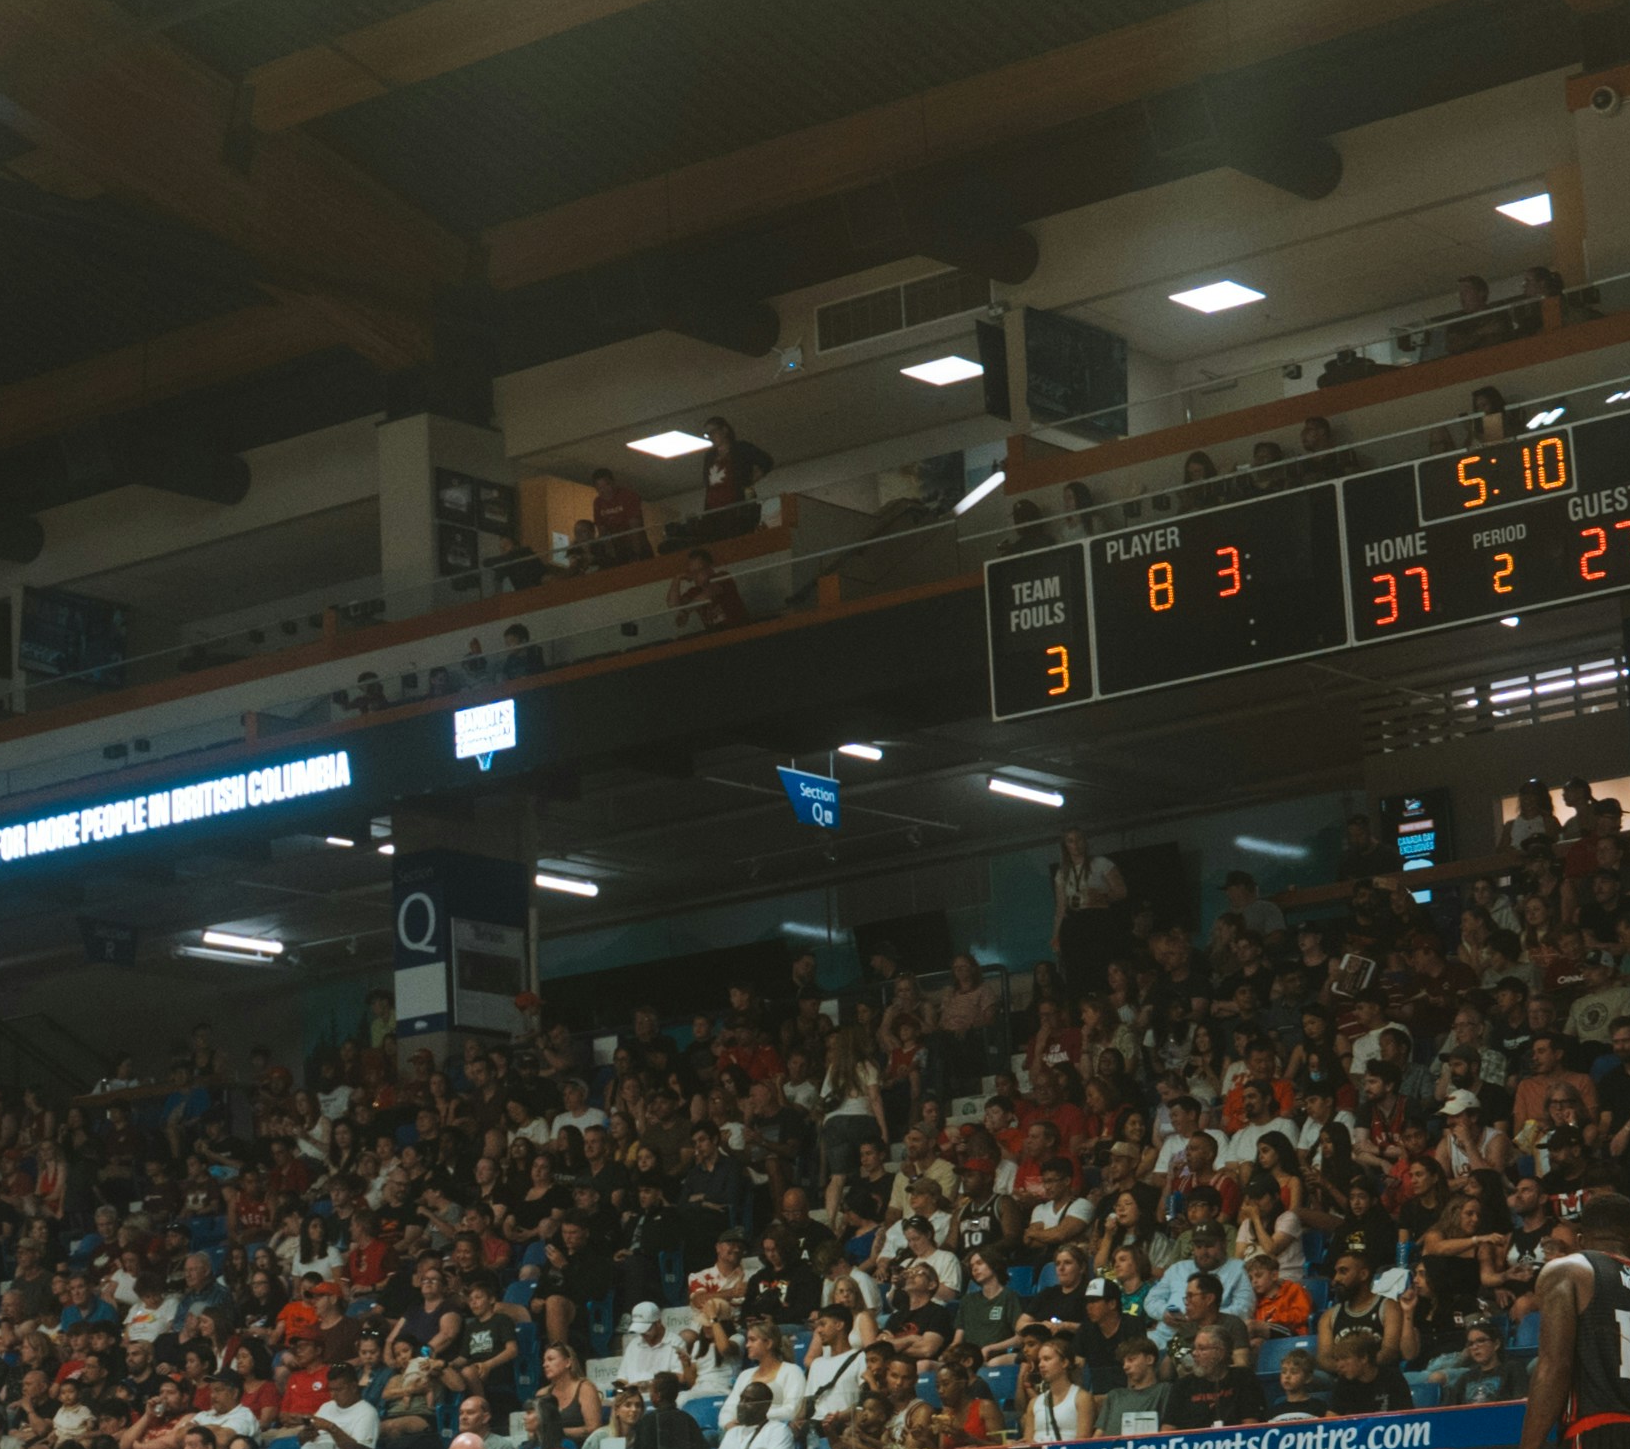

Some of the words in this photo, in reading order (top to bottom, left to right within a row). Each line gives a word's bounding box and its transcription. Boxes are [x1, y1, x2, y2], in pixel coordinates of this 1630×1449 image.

[1457, 437, 1566, 508] 5:10
[1106, 526, 1180, 563] PLAYER
[1364, 532, 1428, 567] HOME
[1473, 523, 1527, 550] PERIOD
[1012, 576, 1060, 605] TEAM
[1148, 561, 1174, 612] 8
[1216, 546, 1240, 598] 3
[1493, 553, 1514, 594] 2
[1372, 566, 1431, 625] 37
[1010, 602, 1065, 632] FOULS
[1046, 645, 1070, 696] 3
[27, 811, 80, 856] MORE
[81, 796, 147, 844] PEOPLE
[148, 791, 170, 829] IN
[171, 774, 246, 824] BRITISH
[247, 751, 351, 807] COLUMBIA
[800, 783, 835, 803] Section
[812, 803, 826, 826] Q
[397, 892, 437, 954] Q
